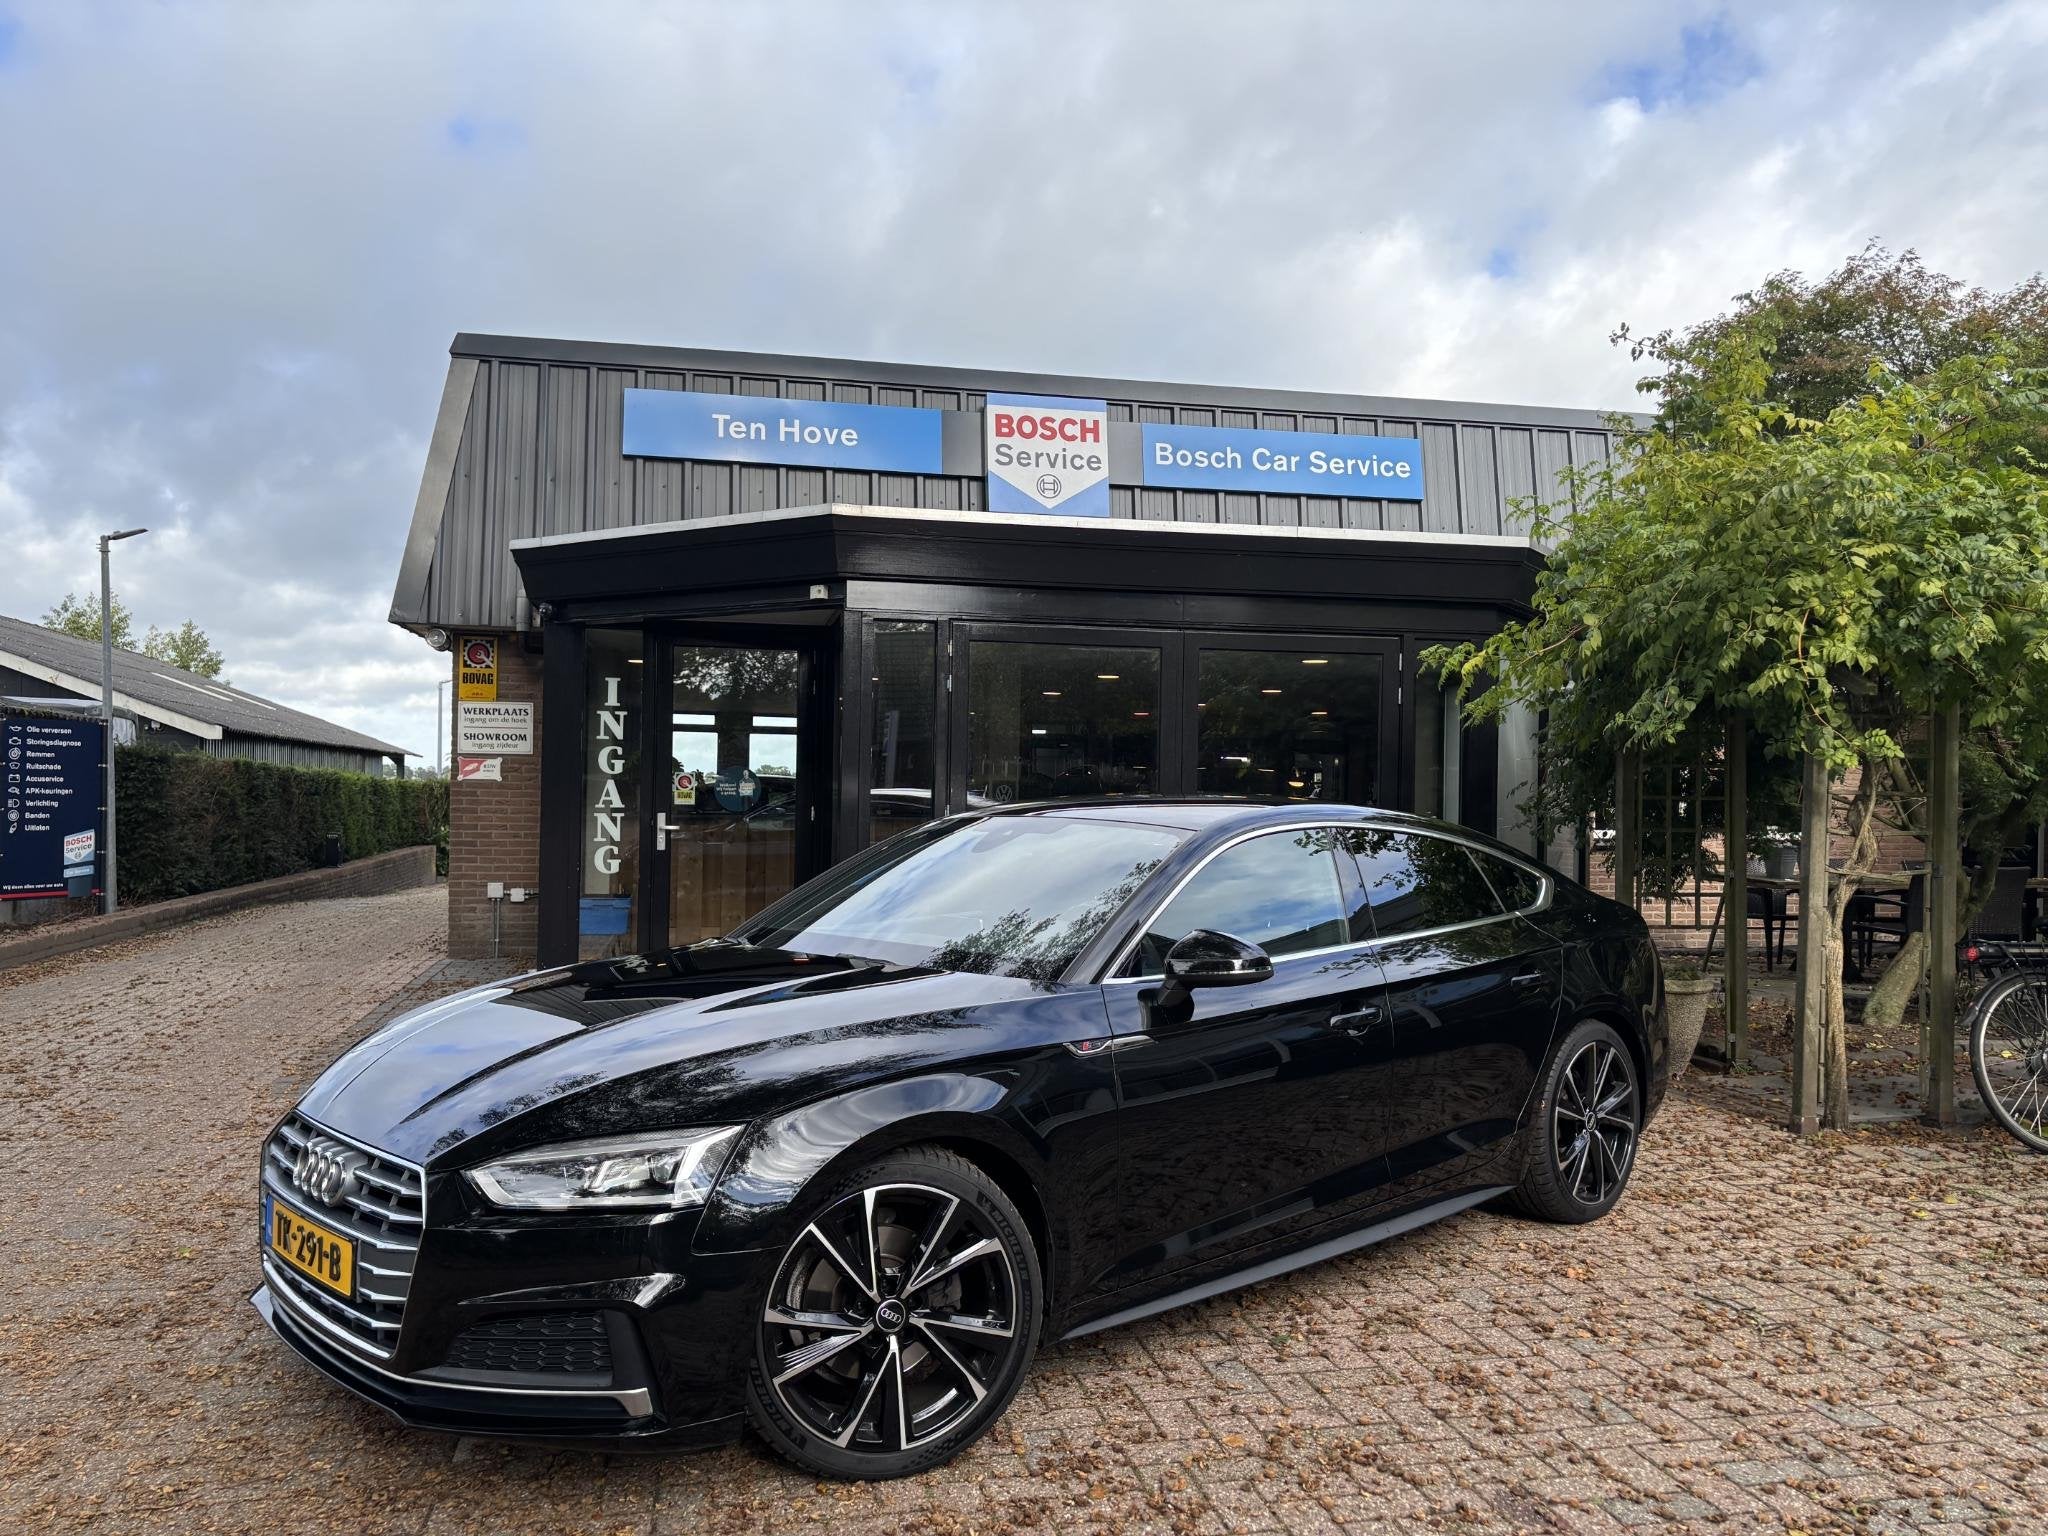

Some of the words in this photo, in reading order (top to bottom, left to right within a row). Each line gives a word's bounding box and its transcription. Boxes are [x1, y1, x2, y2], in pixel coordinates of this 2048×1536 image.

[711, 413, 766, 441] Ten
[779, 418, 859, 447] Hove
[994, 413, 1100, 443] BOSCH
[994, 443, 1103, 472] Service
[1155, 442, 1242, 469] Bosch
[1252, 447, 1300, 472] Car
[1309, 450, 1411, 478] Service
[462, 672, 494, 685] BOVAG
[463, 706, 529, 717] WERKPLAATS
[26, 725, 40, 733] Olie
[41, 727, 72, 735] verversen
[26, 738, 82, 747] Storingsdiagnose
[463, 732, 528, 742] SHOWROOM
[26, 750, 55, 758] Remmen
[26, 762, 62, 770] Ruitschade
[25, 775, 64, 783] Accuservice
[593, 676, 628, 875] INGANG
[25, 787, 73, 796] APK-keuringen
[25, 800, 59, 808] Verlichting
[24, 811, 50, 819] Banden
[65, 834, 93, 847] BOSCH
[65, 843, 93, 854] Service
[274, 1208, 342, 1283] TK-291-B
